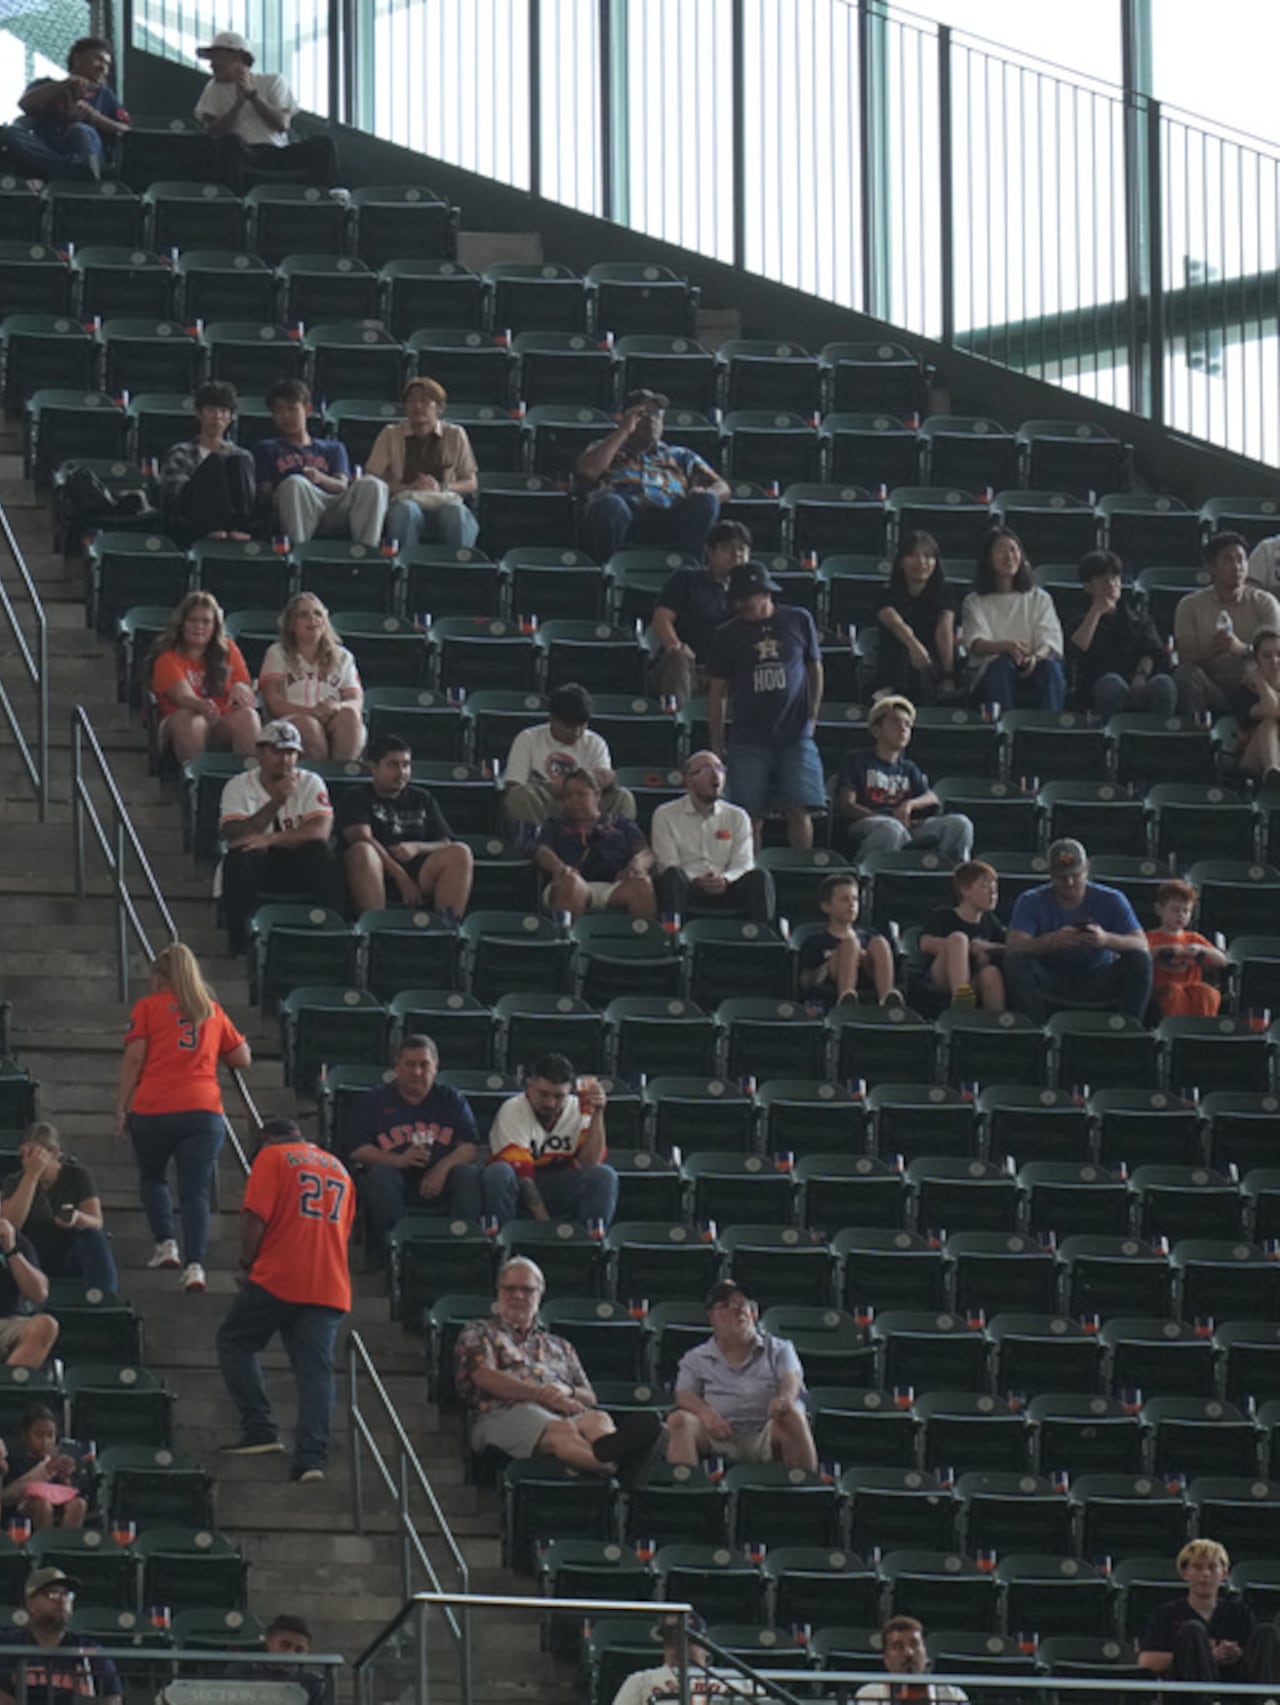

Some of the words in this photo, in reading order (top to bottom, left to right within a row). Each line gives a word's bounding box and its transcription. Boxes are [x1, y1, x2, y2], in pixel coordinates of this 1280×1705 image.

[754, 666, 787, 693] HOU
[178, 1018, 198, 1050] 3
[299, 1171, 345, 1223] 27
